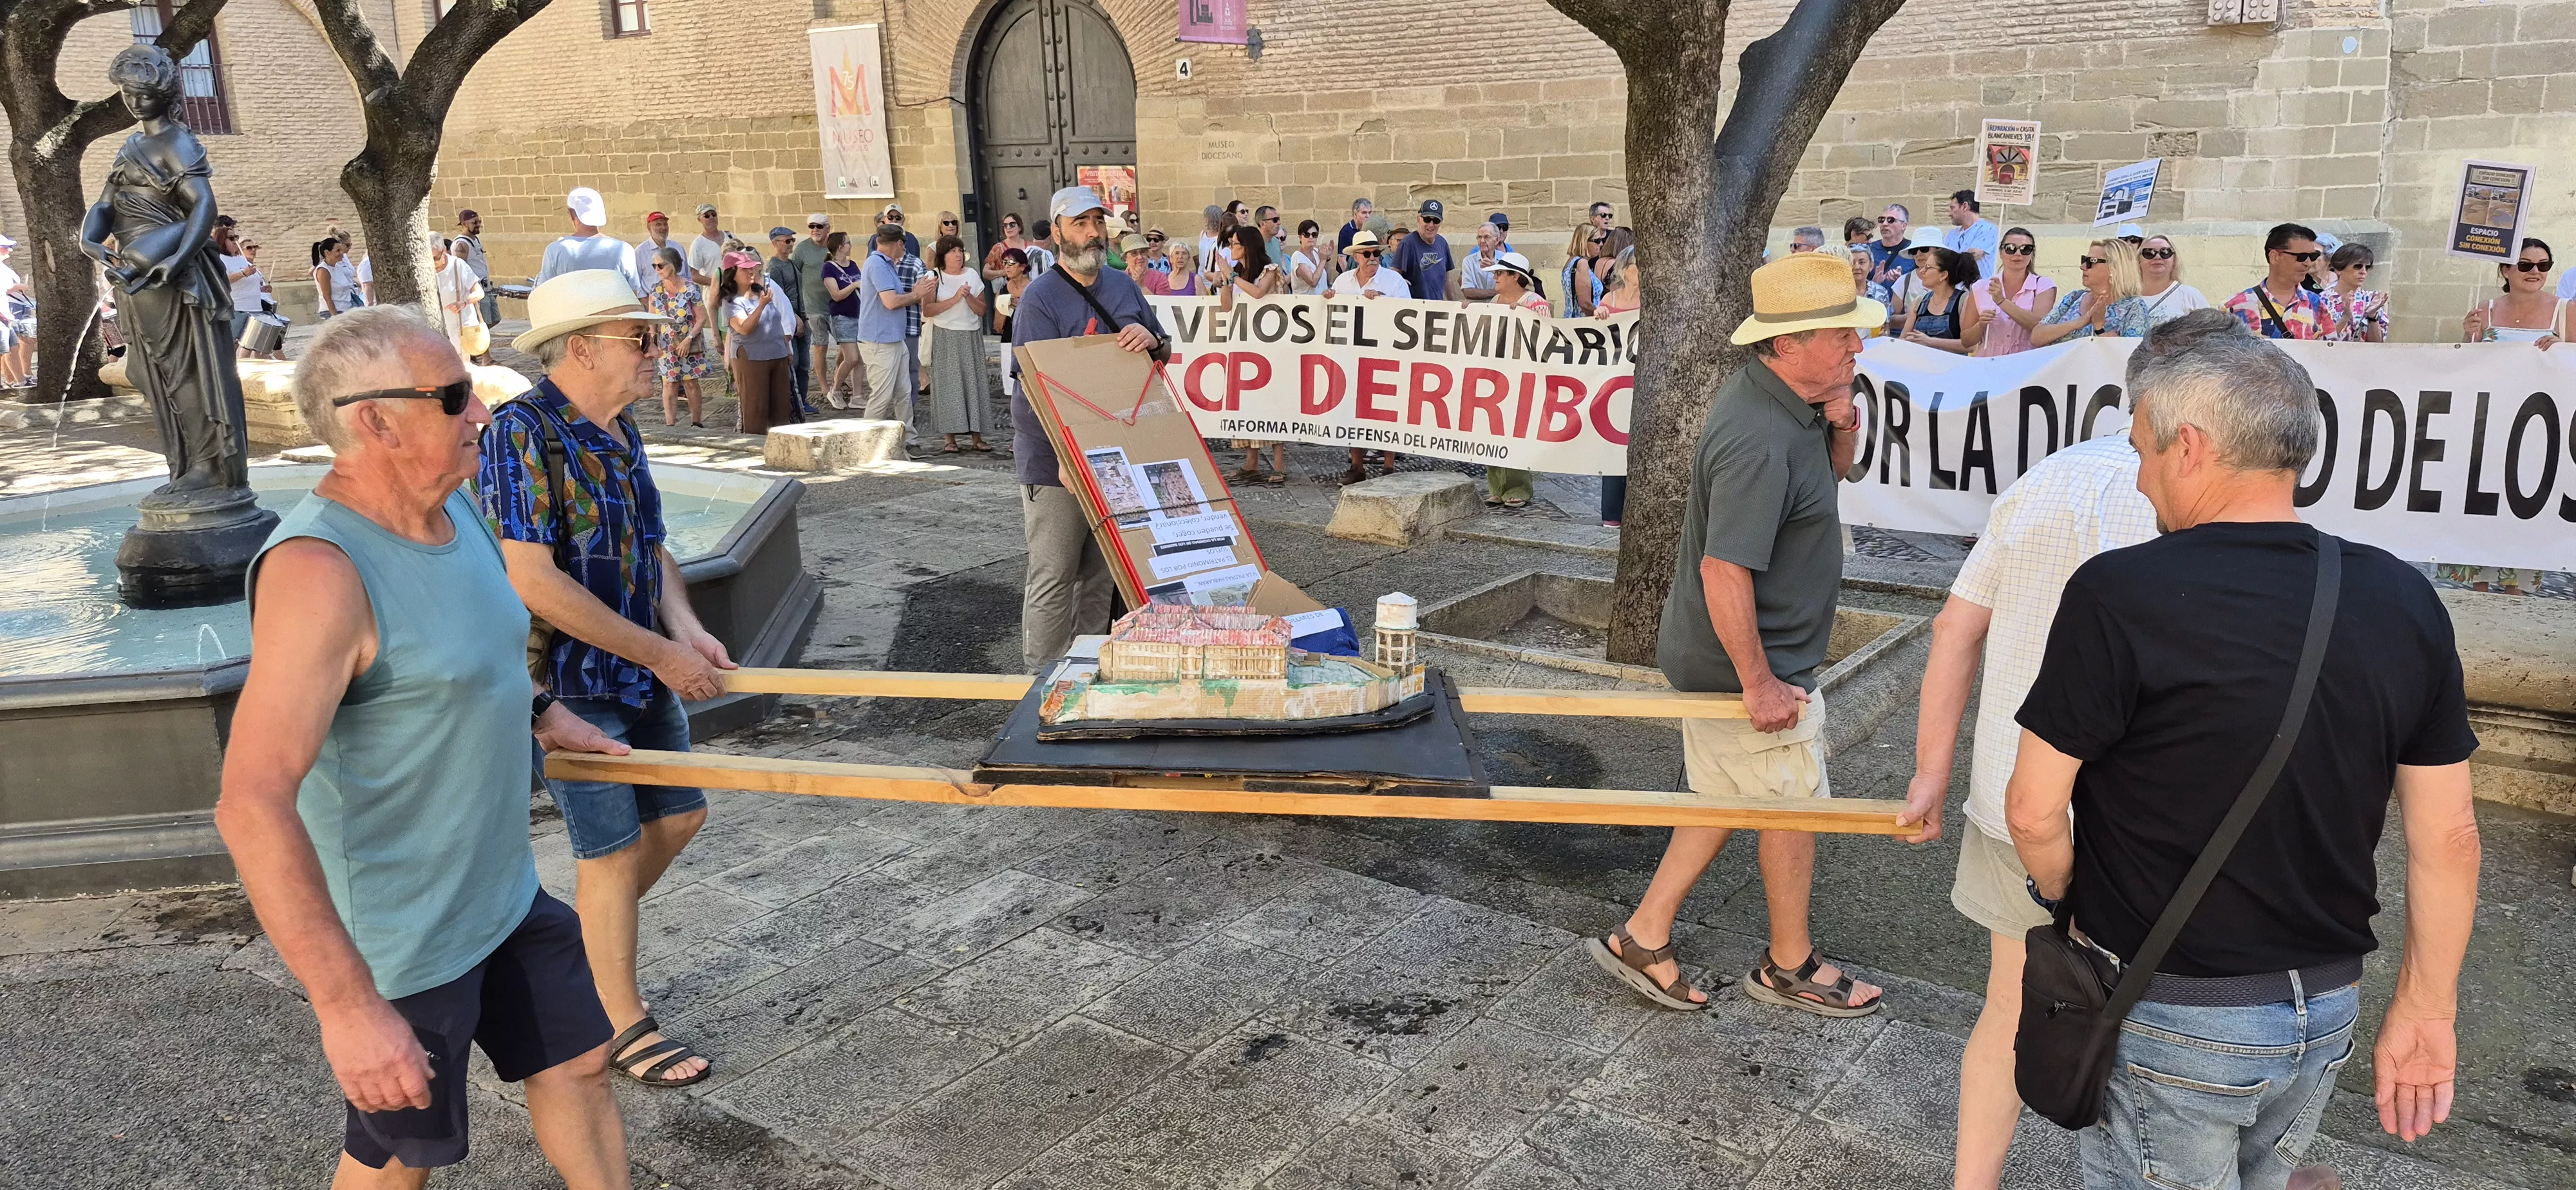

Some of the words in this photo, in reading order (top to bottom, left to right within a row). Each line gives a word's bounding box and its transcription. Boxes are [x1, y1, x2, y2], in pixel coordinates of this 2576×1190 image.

[1180, 61, 1188, 76] 4
[833, 129, 874, 144] MUSEO
[1208, 140, 1235, 149] MUSEO
[1201, 151, 1243, 160] DIOCESANO
[2470, 227, 2499, 236] ESPACIO
[2466, 234, 2501, 245] CONEXIÓN
[2471, 243, 2506, 254] CONEXIÓN
[1325, 304, 1378, 348] EL
[1220, 419, 1288, 434] TAFORMA
[1336, 426, 1400, 444] DEFENSA
[1403, 433, 1427, 449] DEL
[1430, 436, 1509, 459] PATRIMONIO
[1929, 390, 1998, 495] LA
[2354, 388, 2452, 513] DE
[1155, 517, 1200, 530] coleccionar?
[1172, 530, 1196, 538] coger,
[1197, 525, 1224, 535] pueden
[1188, 557, 1226, 569] PATRIMONIO
